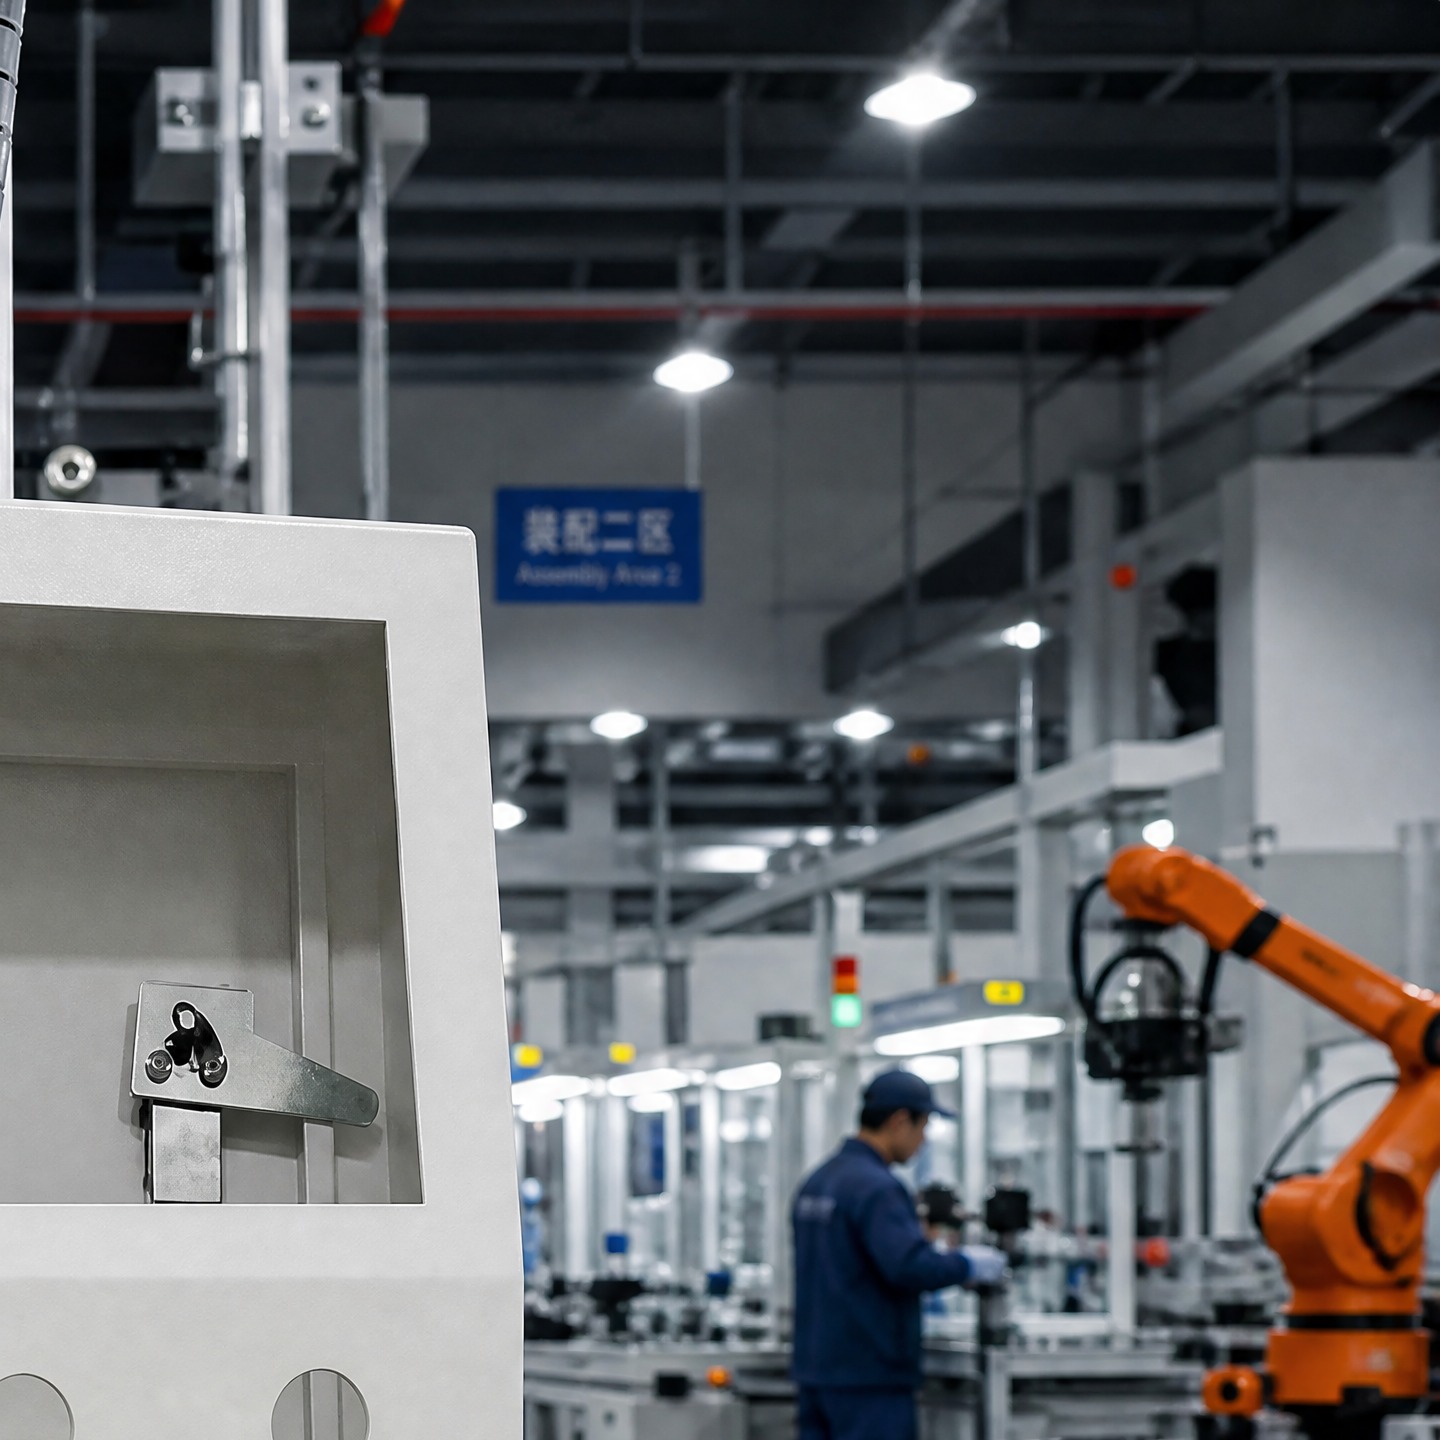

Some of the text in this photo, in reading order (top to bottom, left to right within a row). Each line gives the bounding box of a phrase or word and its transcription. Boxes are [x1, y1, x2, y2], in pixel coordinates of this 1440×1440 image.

[523, 506, 675, 554] 装配二区
[516, 562, 682, 591] Assembly Area 2
